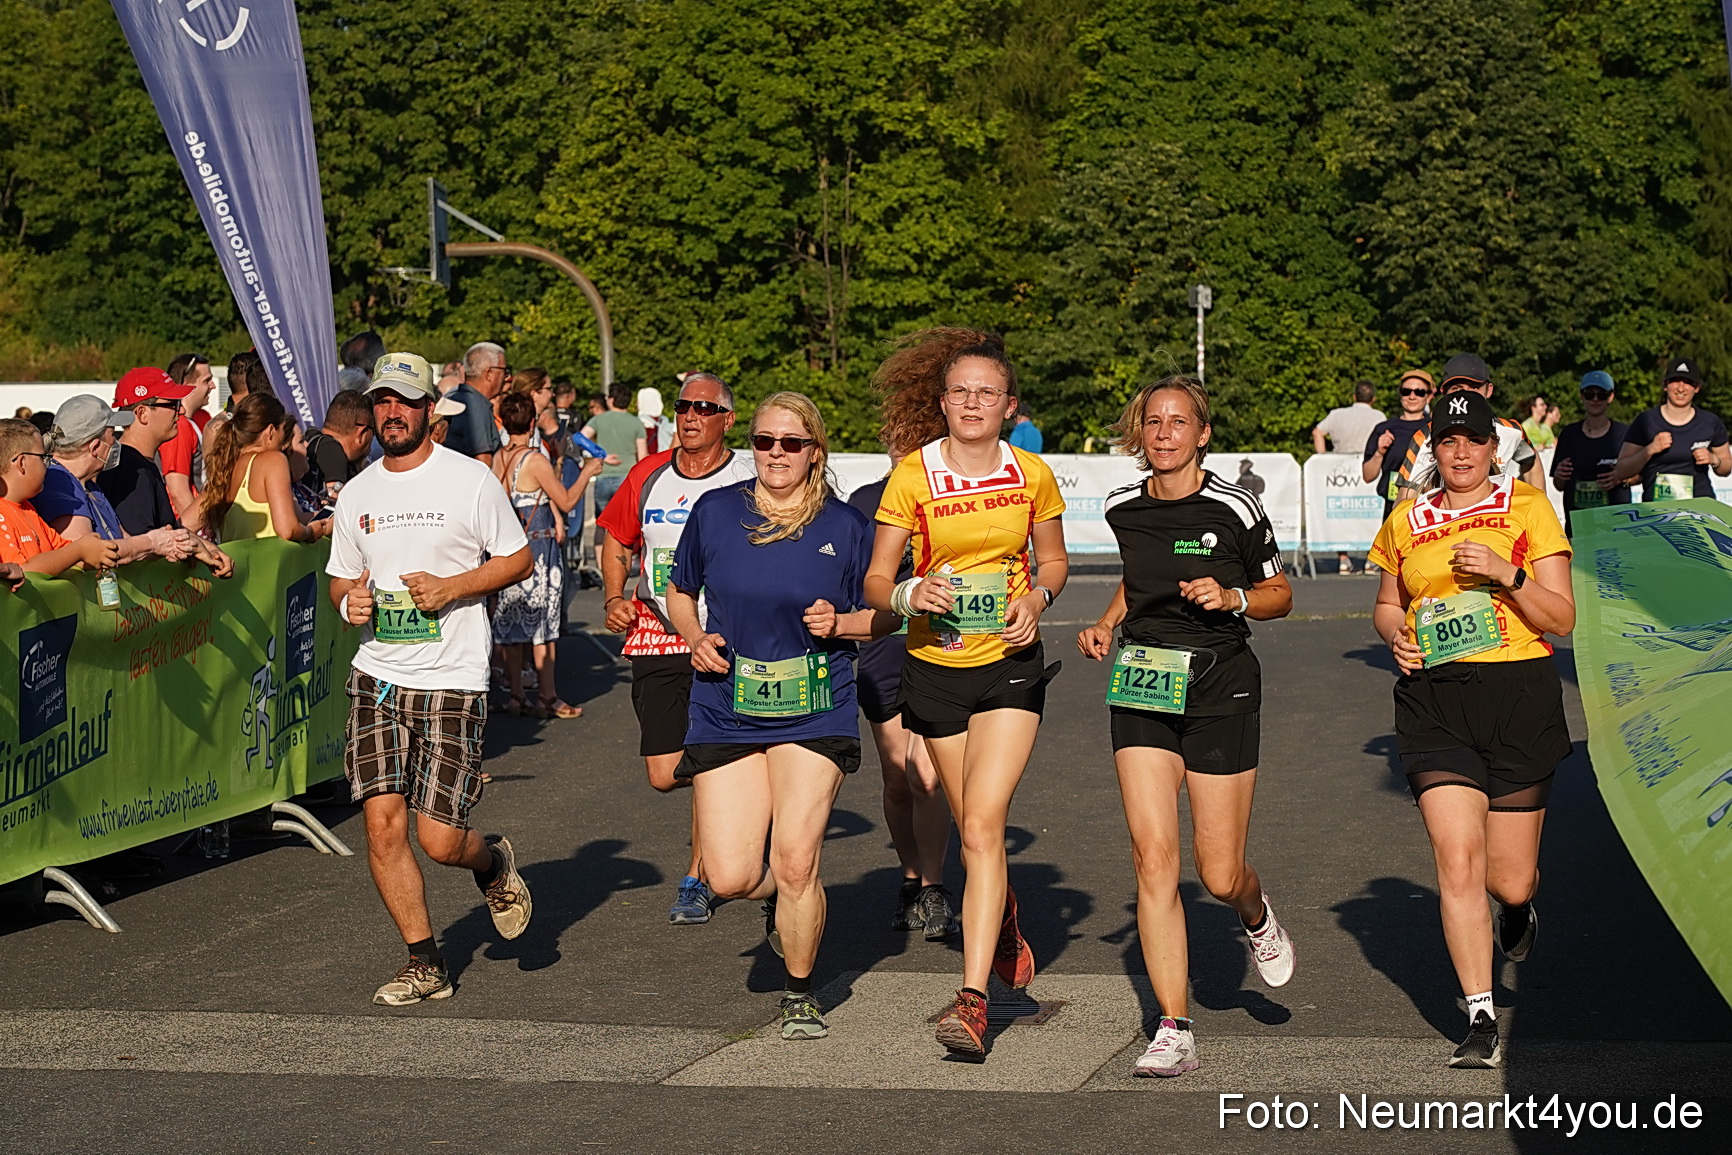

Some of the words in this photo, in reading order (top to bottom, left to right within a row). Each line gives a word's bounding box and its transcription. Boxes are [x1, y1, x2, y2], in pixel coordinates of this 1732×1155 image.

[1326, 474, 1361, 488] NOW
[933, 501, 979, 519] MAX
[983, 493, 1028, 510] BÖGL
[377, 512, 445, 525] SCHWARZ
[377, 523, 412, 532] COMPUTER
[1411, 526, 1452, 549] MAX
[1457, 517, 1511, 533] BÖGL
[1173, 547, 1212, 556] neumarkt
[1174, 540, 1200, 549] physio
[384, 608, 420, 627] 174
[997, 596, 1005, 624] 2022
[380, 627, 402, 635] Krauser
[403, 626, 429, 635] Markus
[1435, 613, 1477, 642] 803
[1483, 611, 1498, 640] 2022
[642, 632, 677, 646] AVIA
[1421, 633, 1433, 655] RUN
[1437, 640, 1460, 653] Mayer
[1461, 634, 1483, 646] Maria
[31, 653, 62, 682] Fischer
[1111, 671, 1121, 693] RUN
[1123, 666, 1171, 692] 1221
[737, 682, 745, 703] RUN
[756, 681, 782, 699] 41
[799, 679, 807, 707] 2022
[1120, 688, 1143, 697] Pürzer
[1143, 691, 1170, 701] Sabine
[1173, 676, 1184, 705] 2022
[743, 697, 772, 707] Pröpster
[773, 698, 800, 707] Carmen
